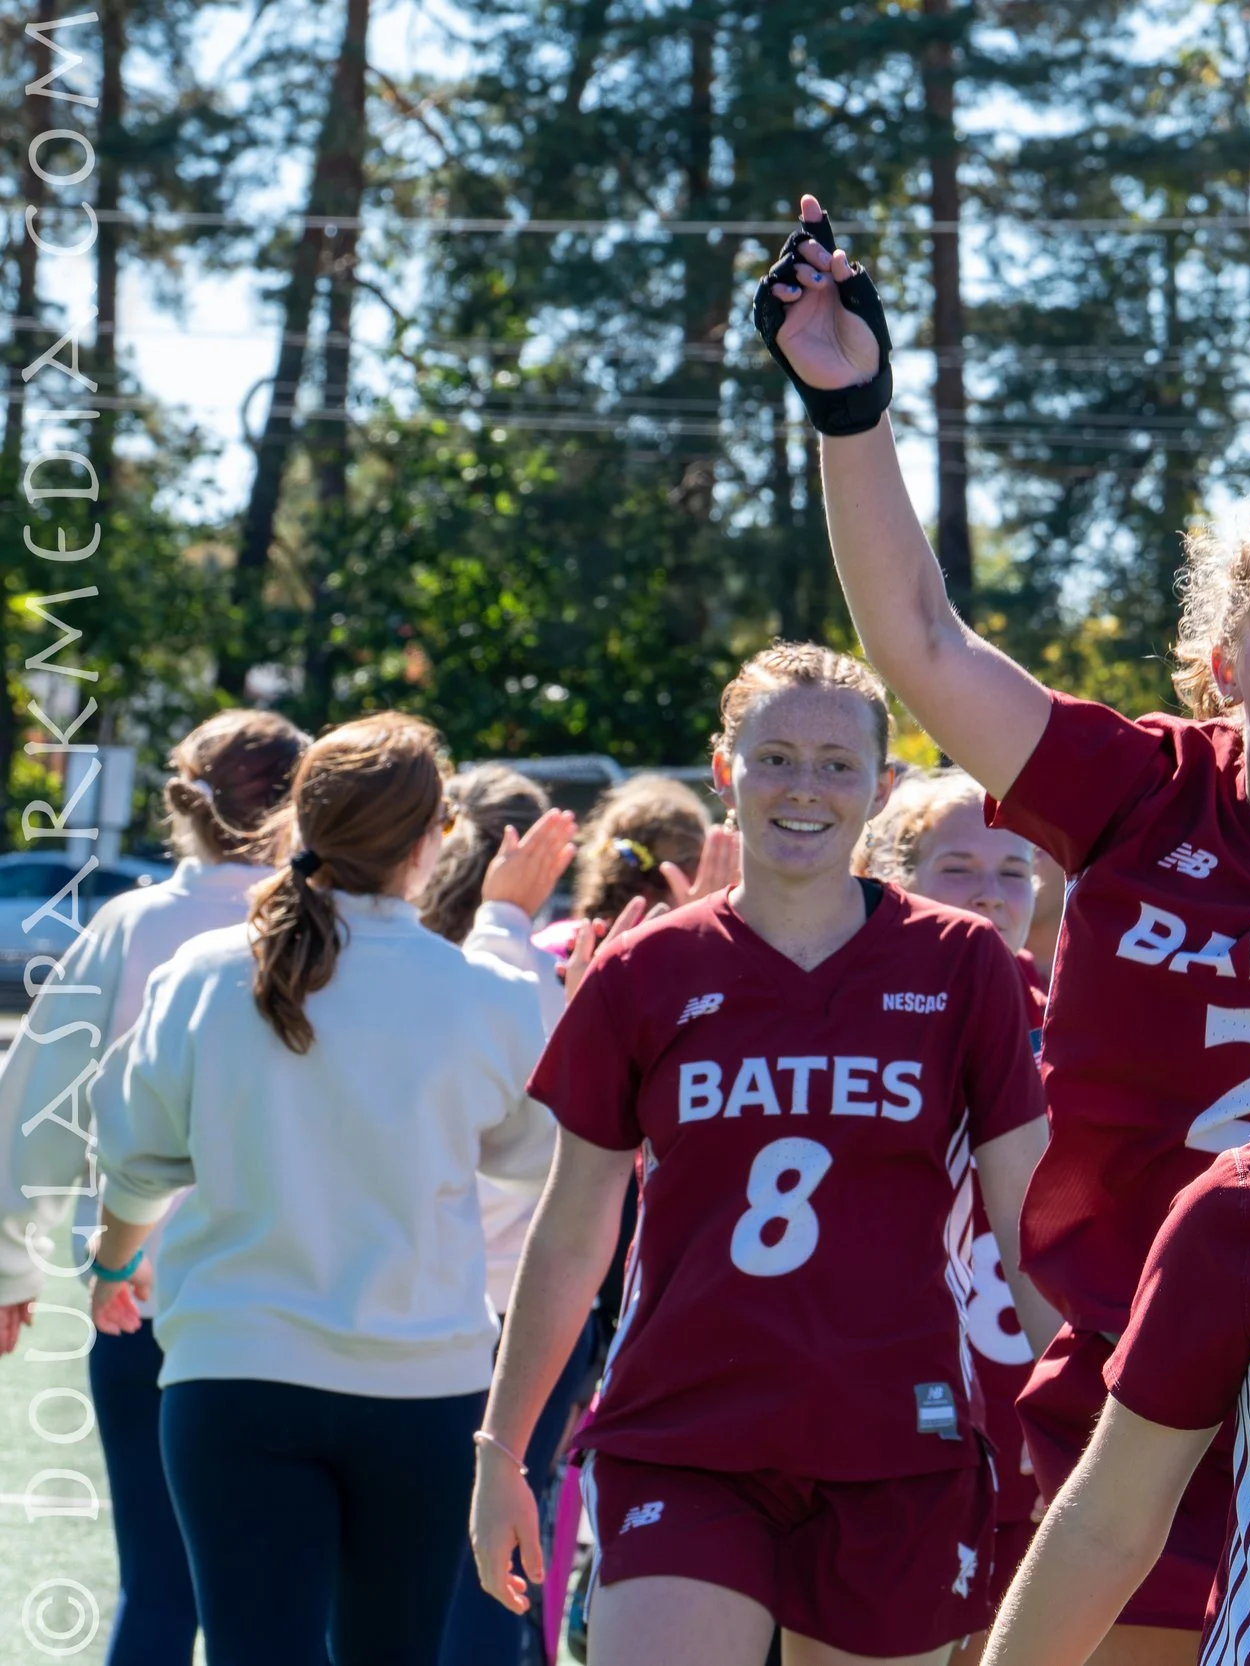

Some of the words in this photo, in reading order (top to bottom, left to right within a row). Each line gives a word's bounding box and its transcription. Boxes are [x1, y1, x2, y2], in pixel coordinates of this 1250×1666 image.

[882, 993, 947, 1014] NESCAC
[678, 1056, 923, 1124] BATES
[730, 1137, 833, 1276] 8
